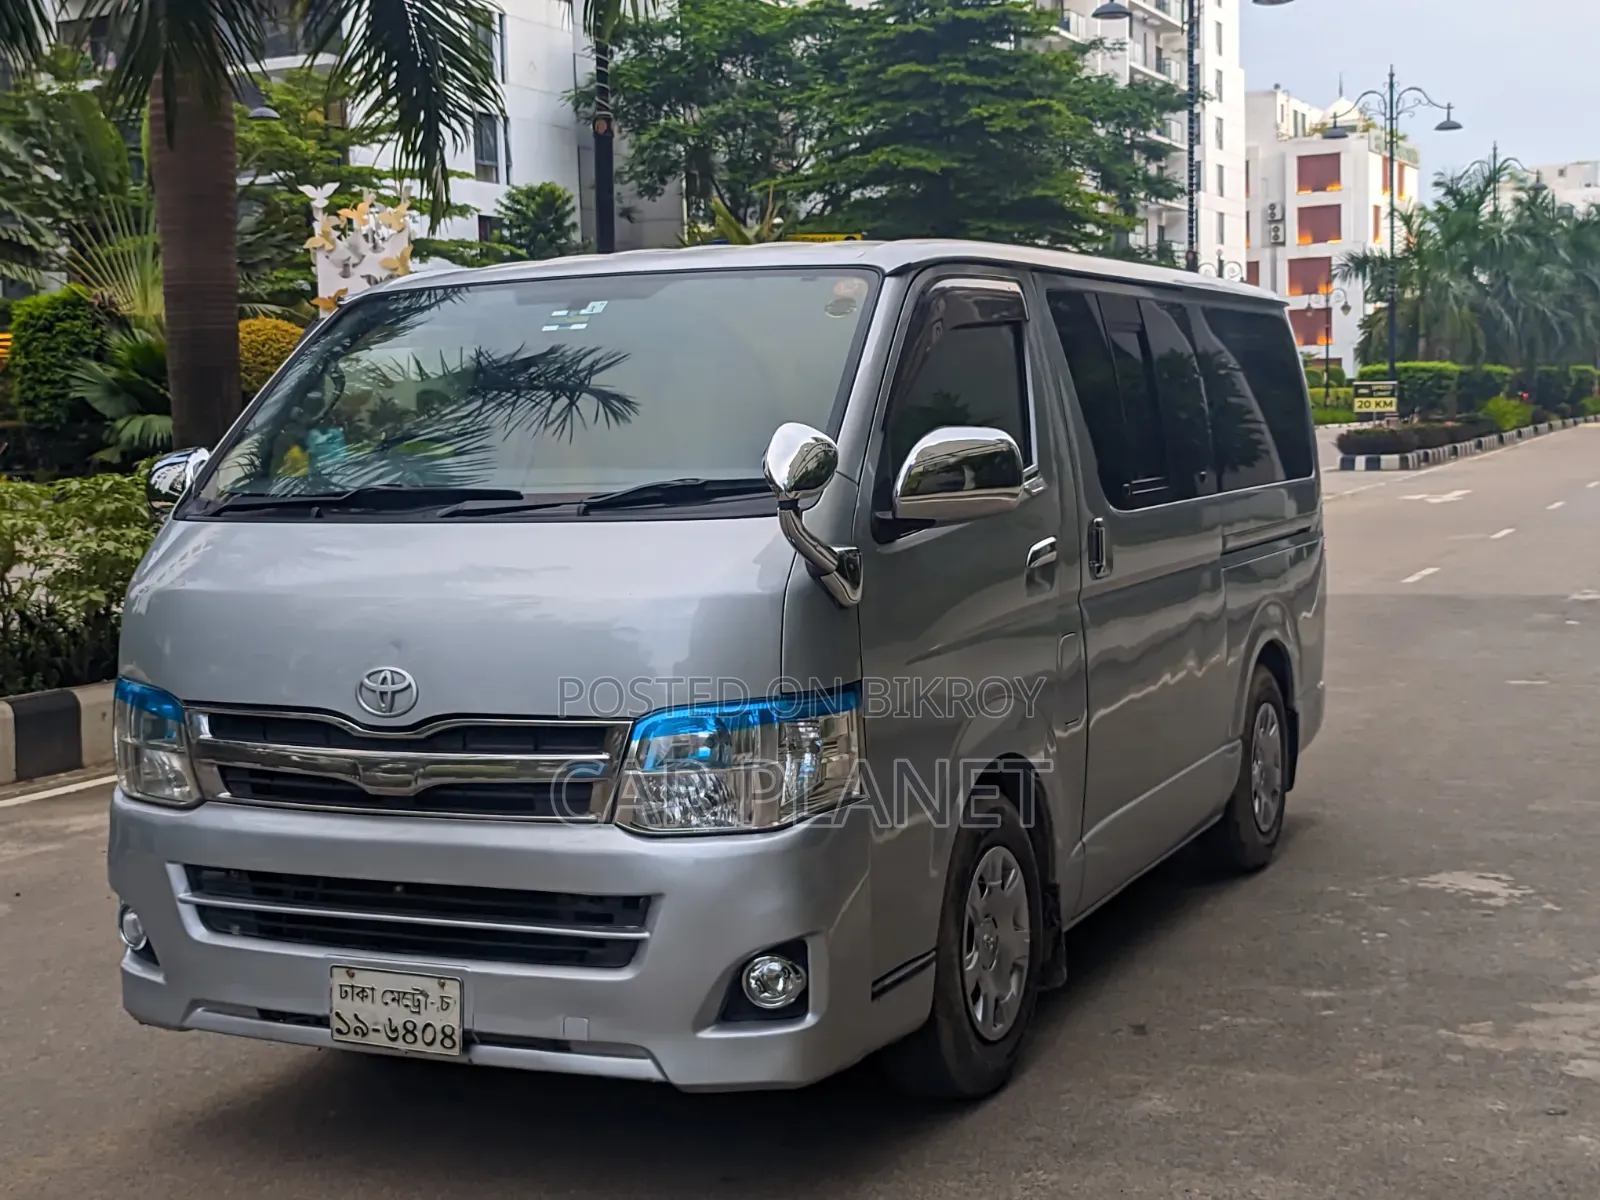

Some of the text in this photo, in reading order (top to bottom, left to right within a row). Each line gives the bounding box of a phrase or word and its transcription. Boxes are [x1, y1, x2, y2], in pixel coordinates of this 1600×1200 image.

[1357, 400, 1393, 409] 20 KM
[338, 983, 376, 1004] ঢাকা
[334, 1010, 457, 1050] ১৯-৬৪০৪
